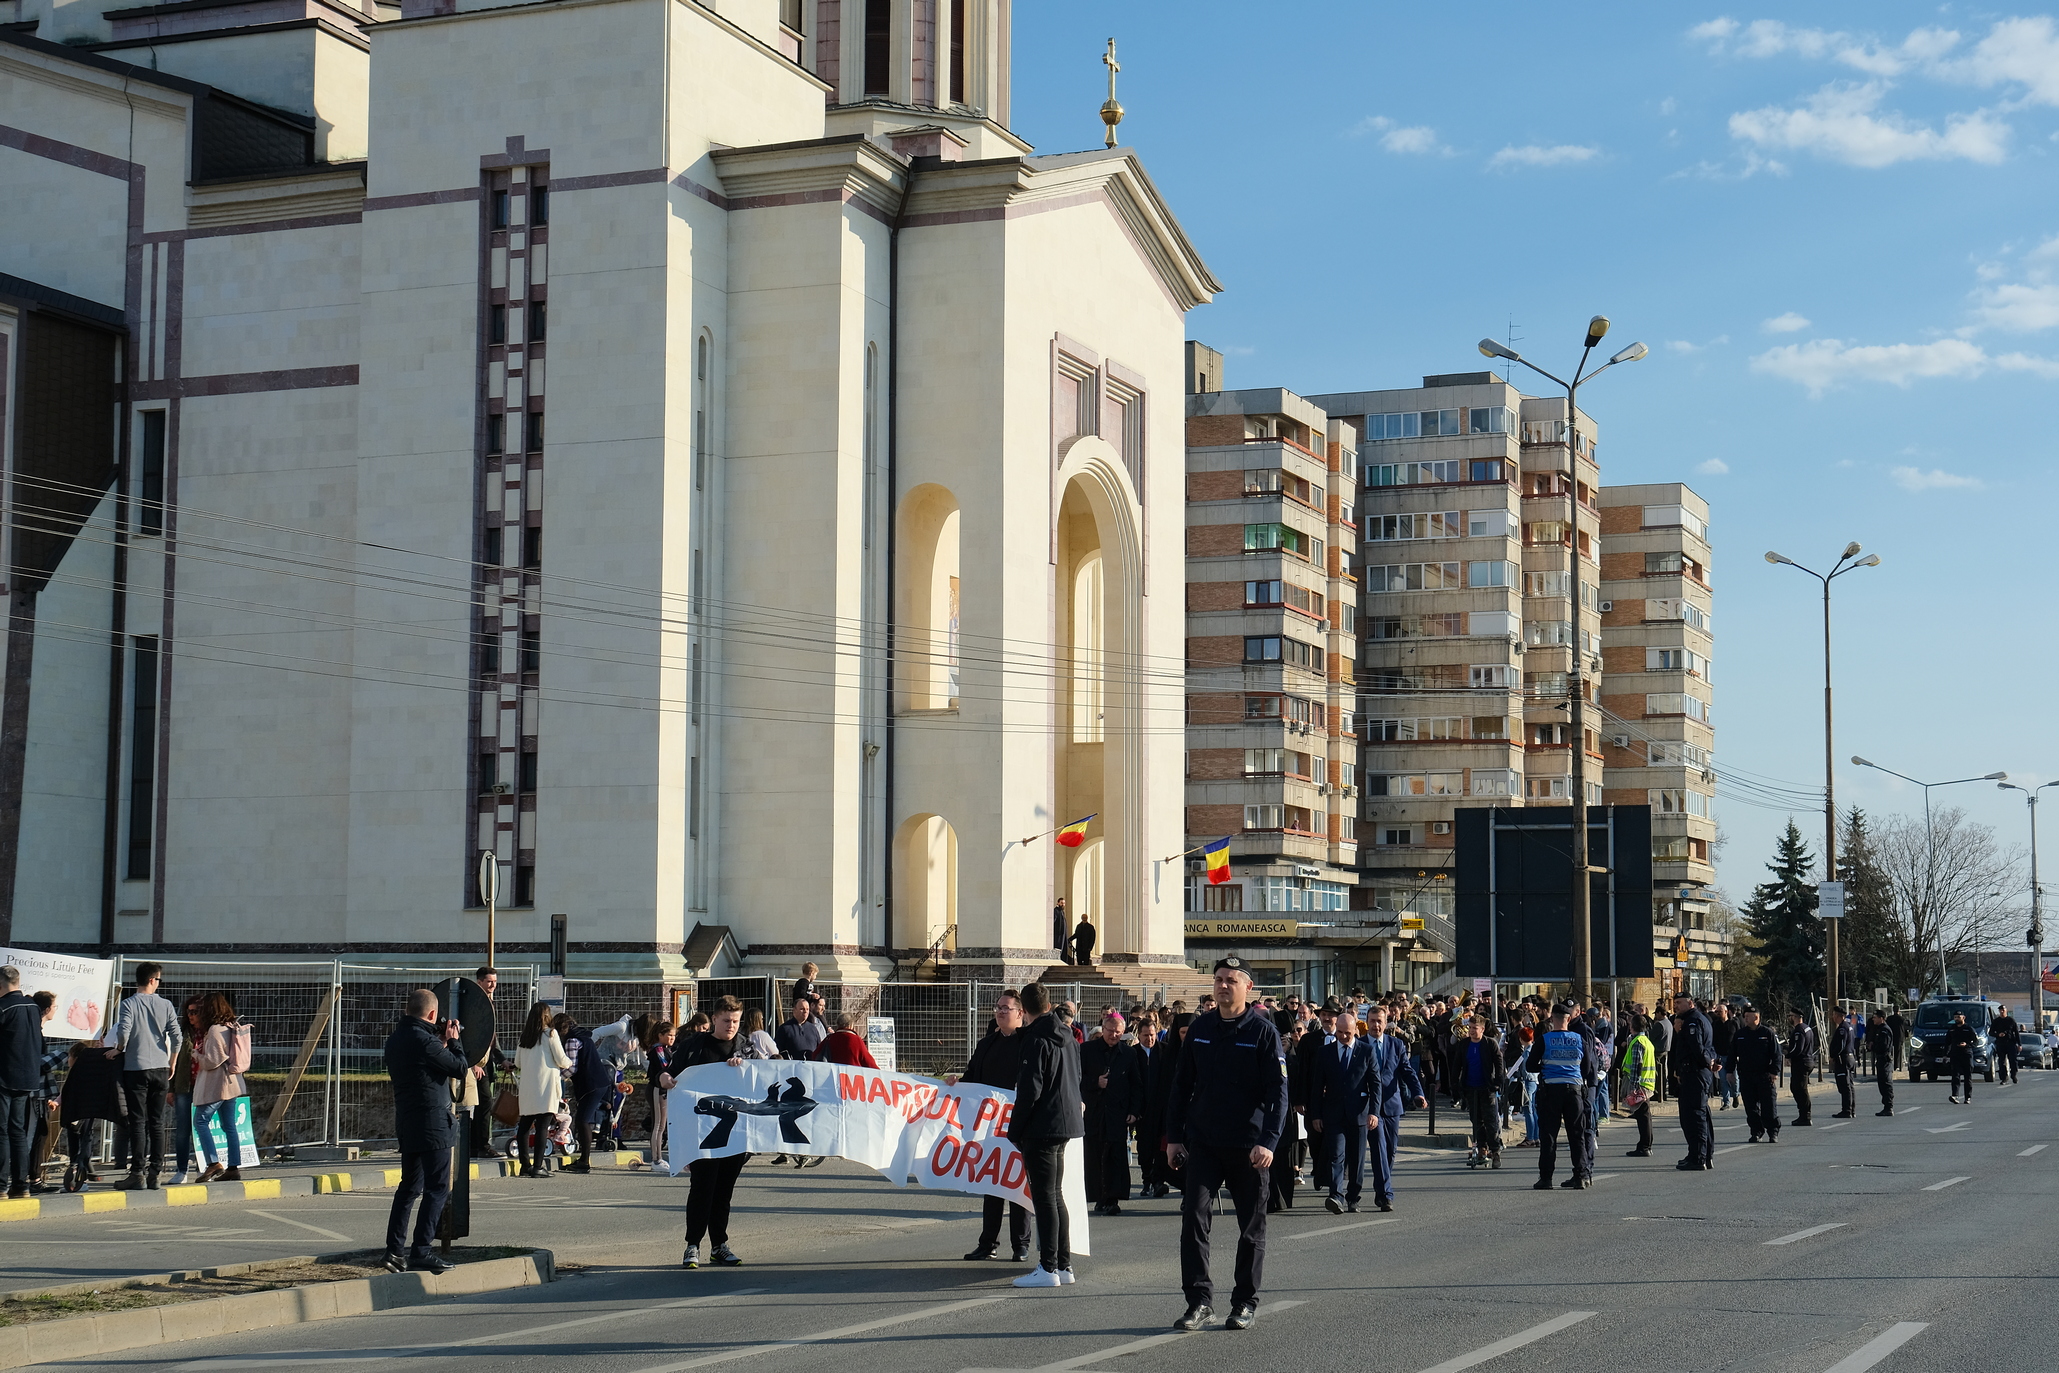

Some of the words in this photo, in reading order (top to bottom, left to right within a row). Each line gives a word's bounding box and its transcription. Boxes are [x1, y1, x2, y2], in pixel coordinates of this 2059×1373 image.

[1184, 924, 1210, 933] ANCA
[1216, 924, 1287, 933] ROMANEASCA
[5, 954, 49, 969] Precious
[52, 960, 76, 972] Little
[77, 963, 95, 975] Feet
[1911, 988, 1917, 997] P
[1551, 1038, 1577, 1046] DIALOG
[972, 1097, 1015, 1138] PE
[931, 1135, 1032, 1199] ORAD
